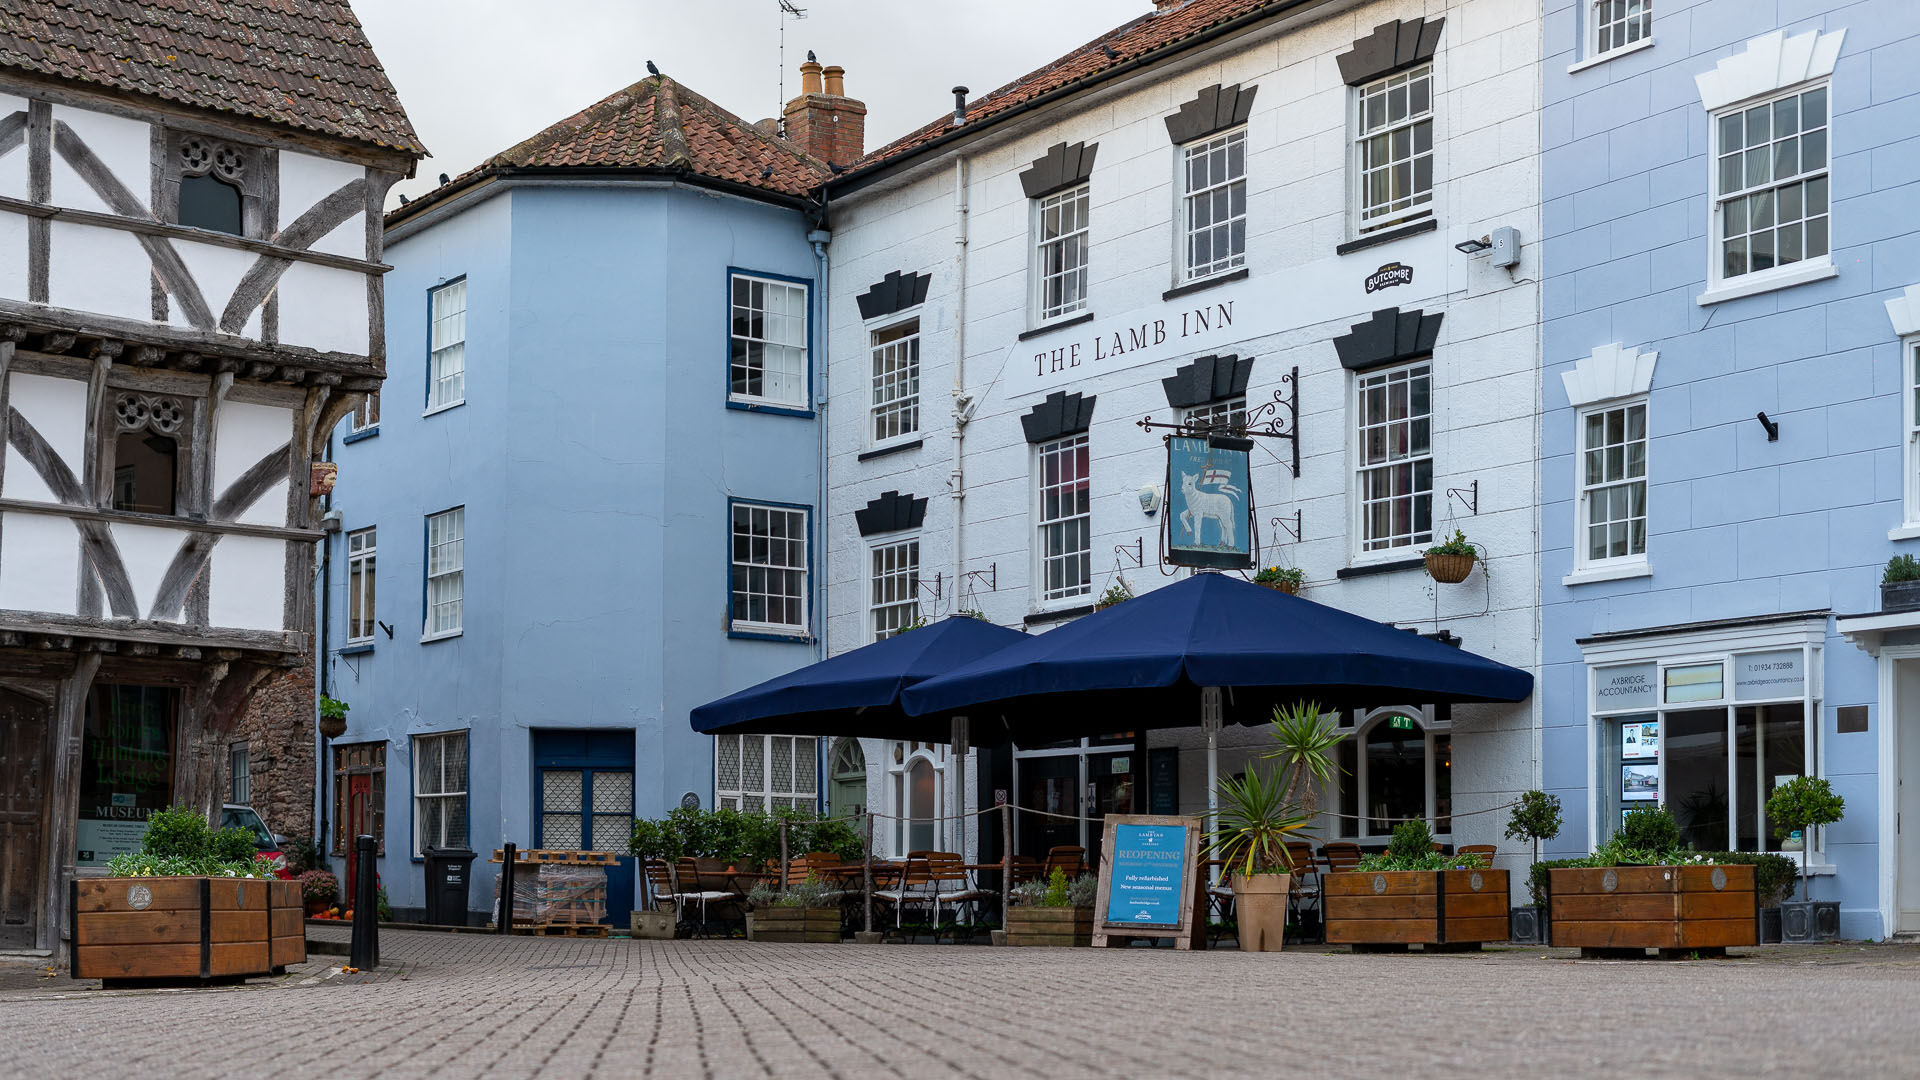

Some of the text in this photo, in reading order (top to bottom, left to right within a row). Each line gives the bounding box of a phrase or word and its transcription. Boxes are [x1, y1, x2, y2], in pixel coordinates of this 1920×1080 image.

[1367, 269, 1410, 290] BUTCOMBE
[1034, 300, 1234, 376] THE LAMB INN
[1173, 438, 1210, 454] LAMB
[1753, 663, 1772, 672] 01934
[1773, 661, 1793, 670] 732888
[1611, 674, 1646, 686] AXBRIDGE
[1598, 685, 1652, 697] ACCOUNTANCY
[91, 739, 167, 771] Hunting
[96, 763, 161, 793] Lodge
[1119, 850, 1181, 860] REOPENING
